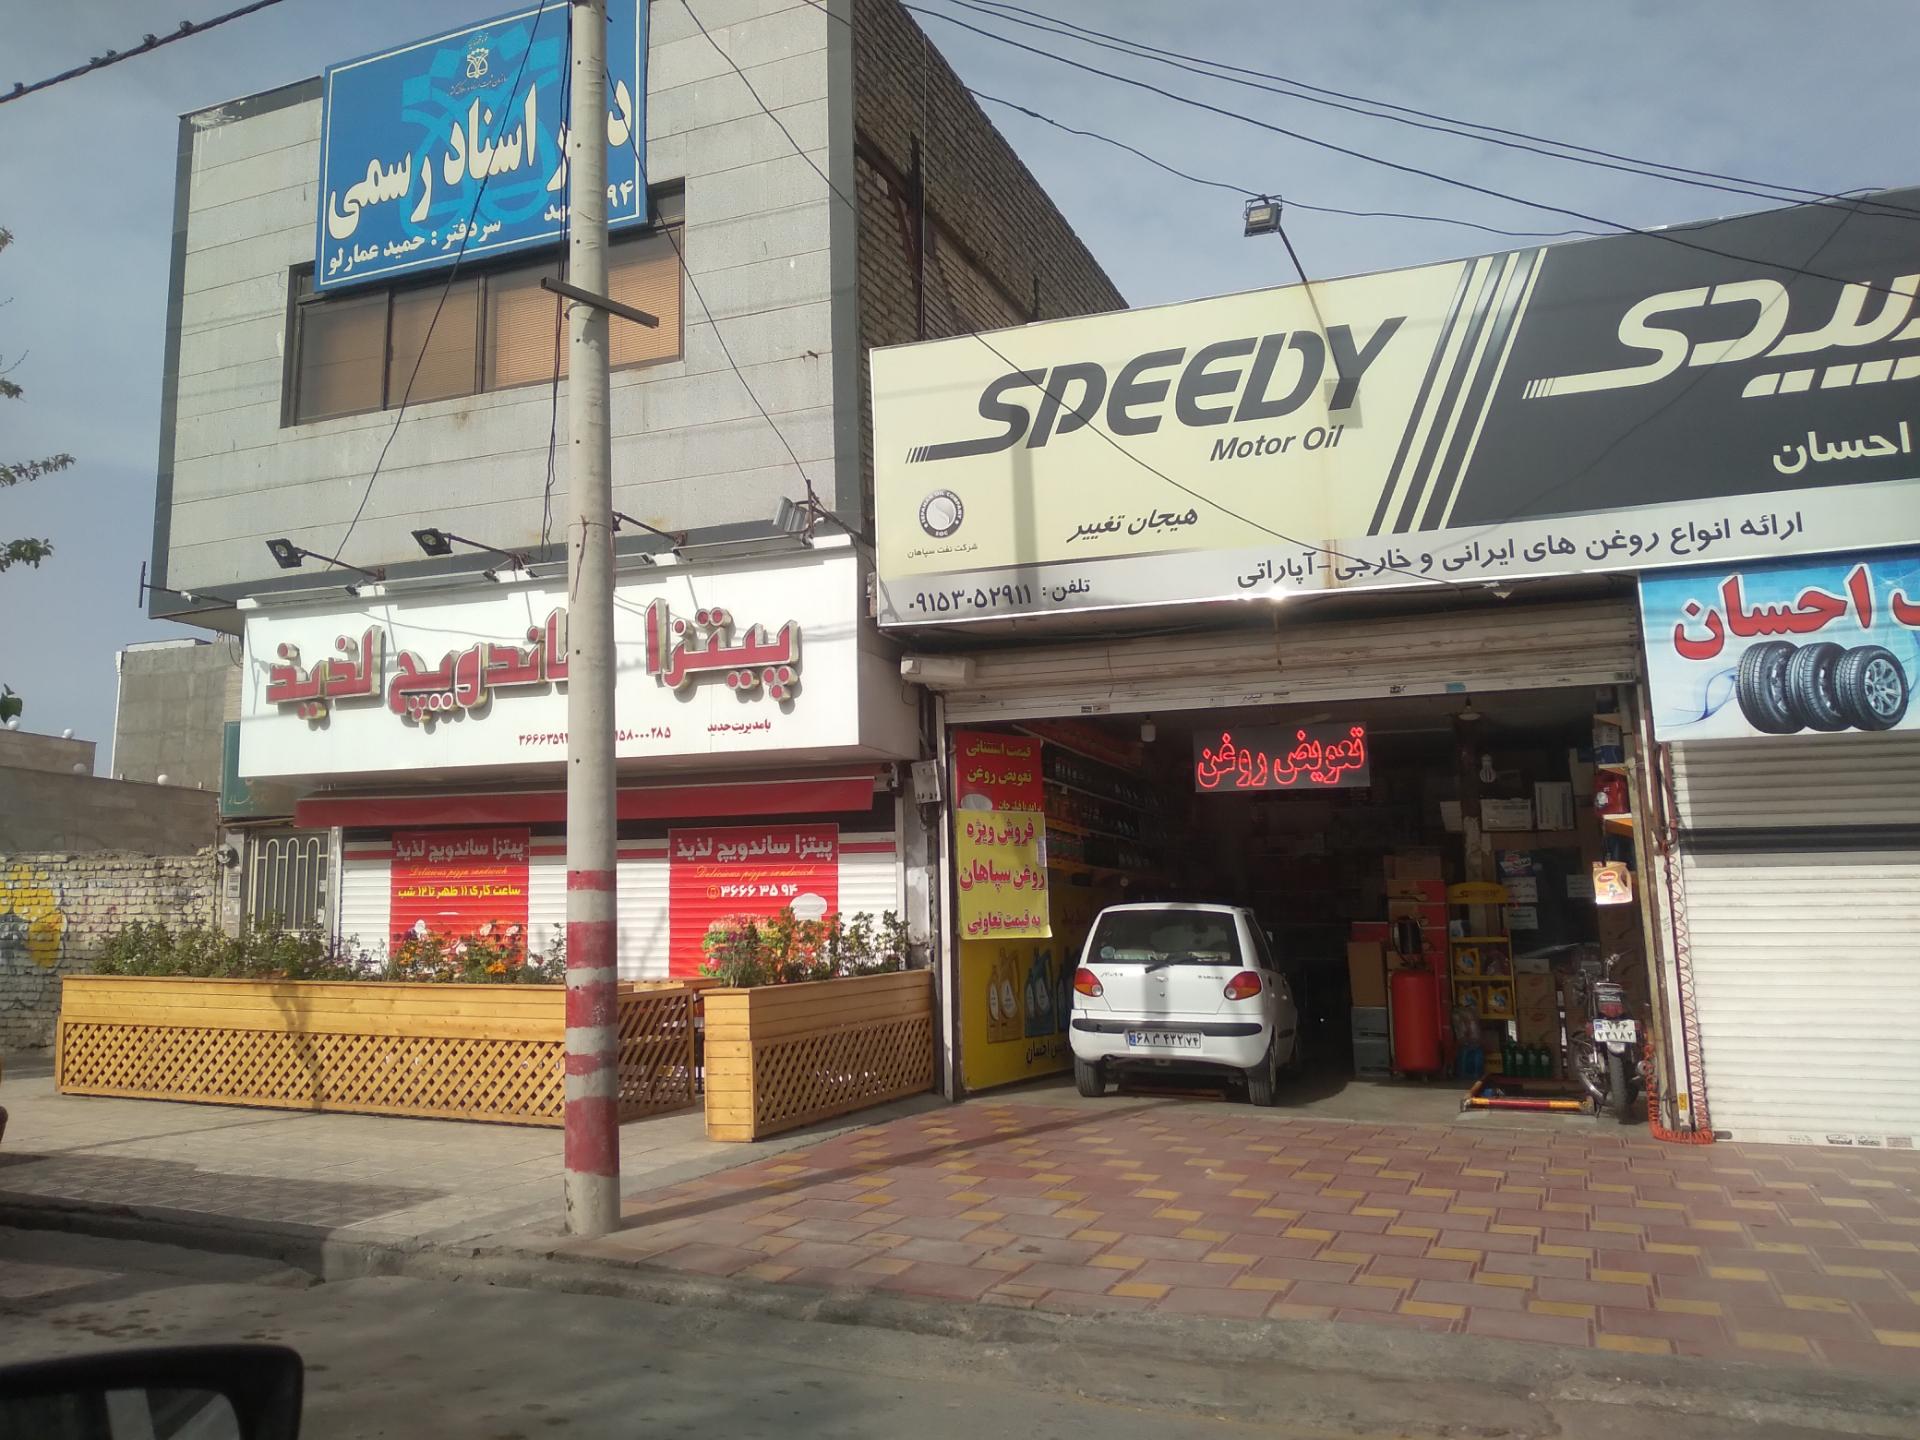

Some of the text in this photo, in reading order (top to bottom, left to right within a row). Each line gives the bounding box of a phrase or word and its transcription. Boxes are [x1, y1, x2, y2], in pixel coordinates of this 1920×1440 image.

[443, 80, 538, 186] اسناد
[328, 151, 432, 240] رسمی
[327, 241, 379, 277] عمارلو
[383, 234, 425, 259] حمید
[906, 316, 1408, 464] SPEEDY
[1209, 425, 1344, 463] Motor Oil
[1772, 421, 1911, 474] احسان
[1066, 508, 1199, 543] هیجان تغییر
[1669, 518, 1731, 555] انواع
[1740, 511, 1804, 541] ارائه
[906, 543, 978, 560] شرکت نفت سپاهان
[1442, 538, 1514, 571] ایرانی
[1523, 534, 1577, 563] های
[1585, 529, 1660, 560] روغن
[1419, 552, 1434, 574] و
[908, 583, 1032, 613] ۰۹۱۵۳۰۵۲۹۱۱
[1673, 564, 1874, 661] احسان
[265, 598, 800, 723] پیتزا اندویچ لذیذ
[706, 721, 732, 737] جدید
[1197, 726, 1365, 788] تعویض روغن
[966, 764, 1032, 786] تعویض روغن
[965, 818, 1035, 847] فروش ویژه
[396, 837, 524, 863] پیتزا ساندویچ لذیذ
[676, 834, 833, 863] پیتزا ساندویچ لذیذ
[959, 858, 1046, 893] روغن سپاهان
[398, 886, 416, 898] شب
[436, 884, 459, 899] ظهر
[469, 883, 491, 899] کاری
[492, 884, 521, 897] ساعت
[720, 883, 799, 898] ۳۶۶۶ ۳۵ ۹۴
[966, 911, 1002, 935] تعاونی
[1003, 909, 1030, 933] قیمت
[1031, 913, 1042, 932] به
